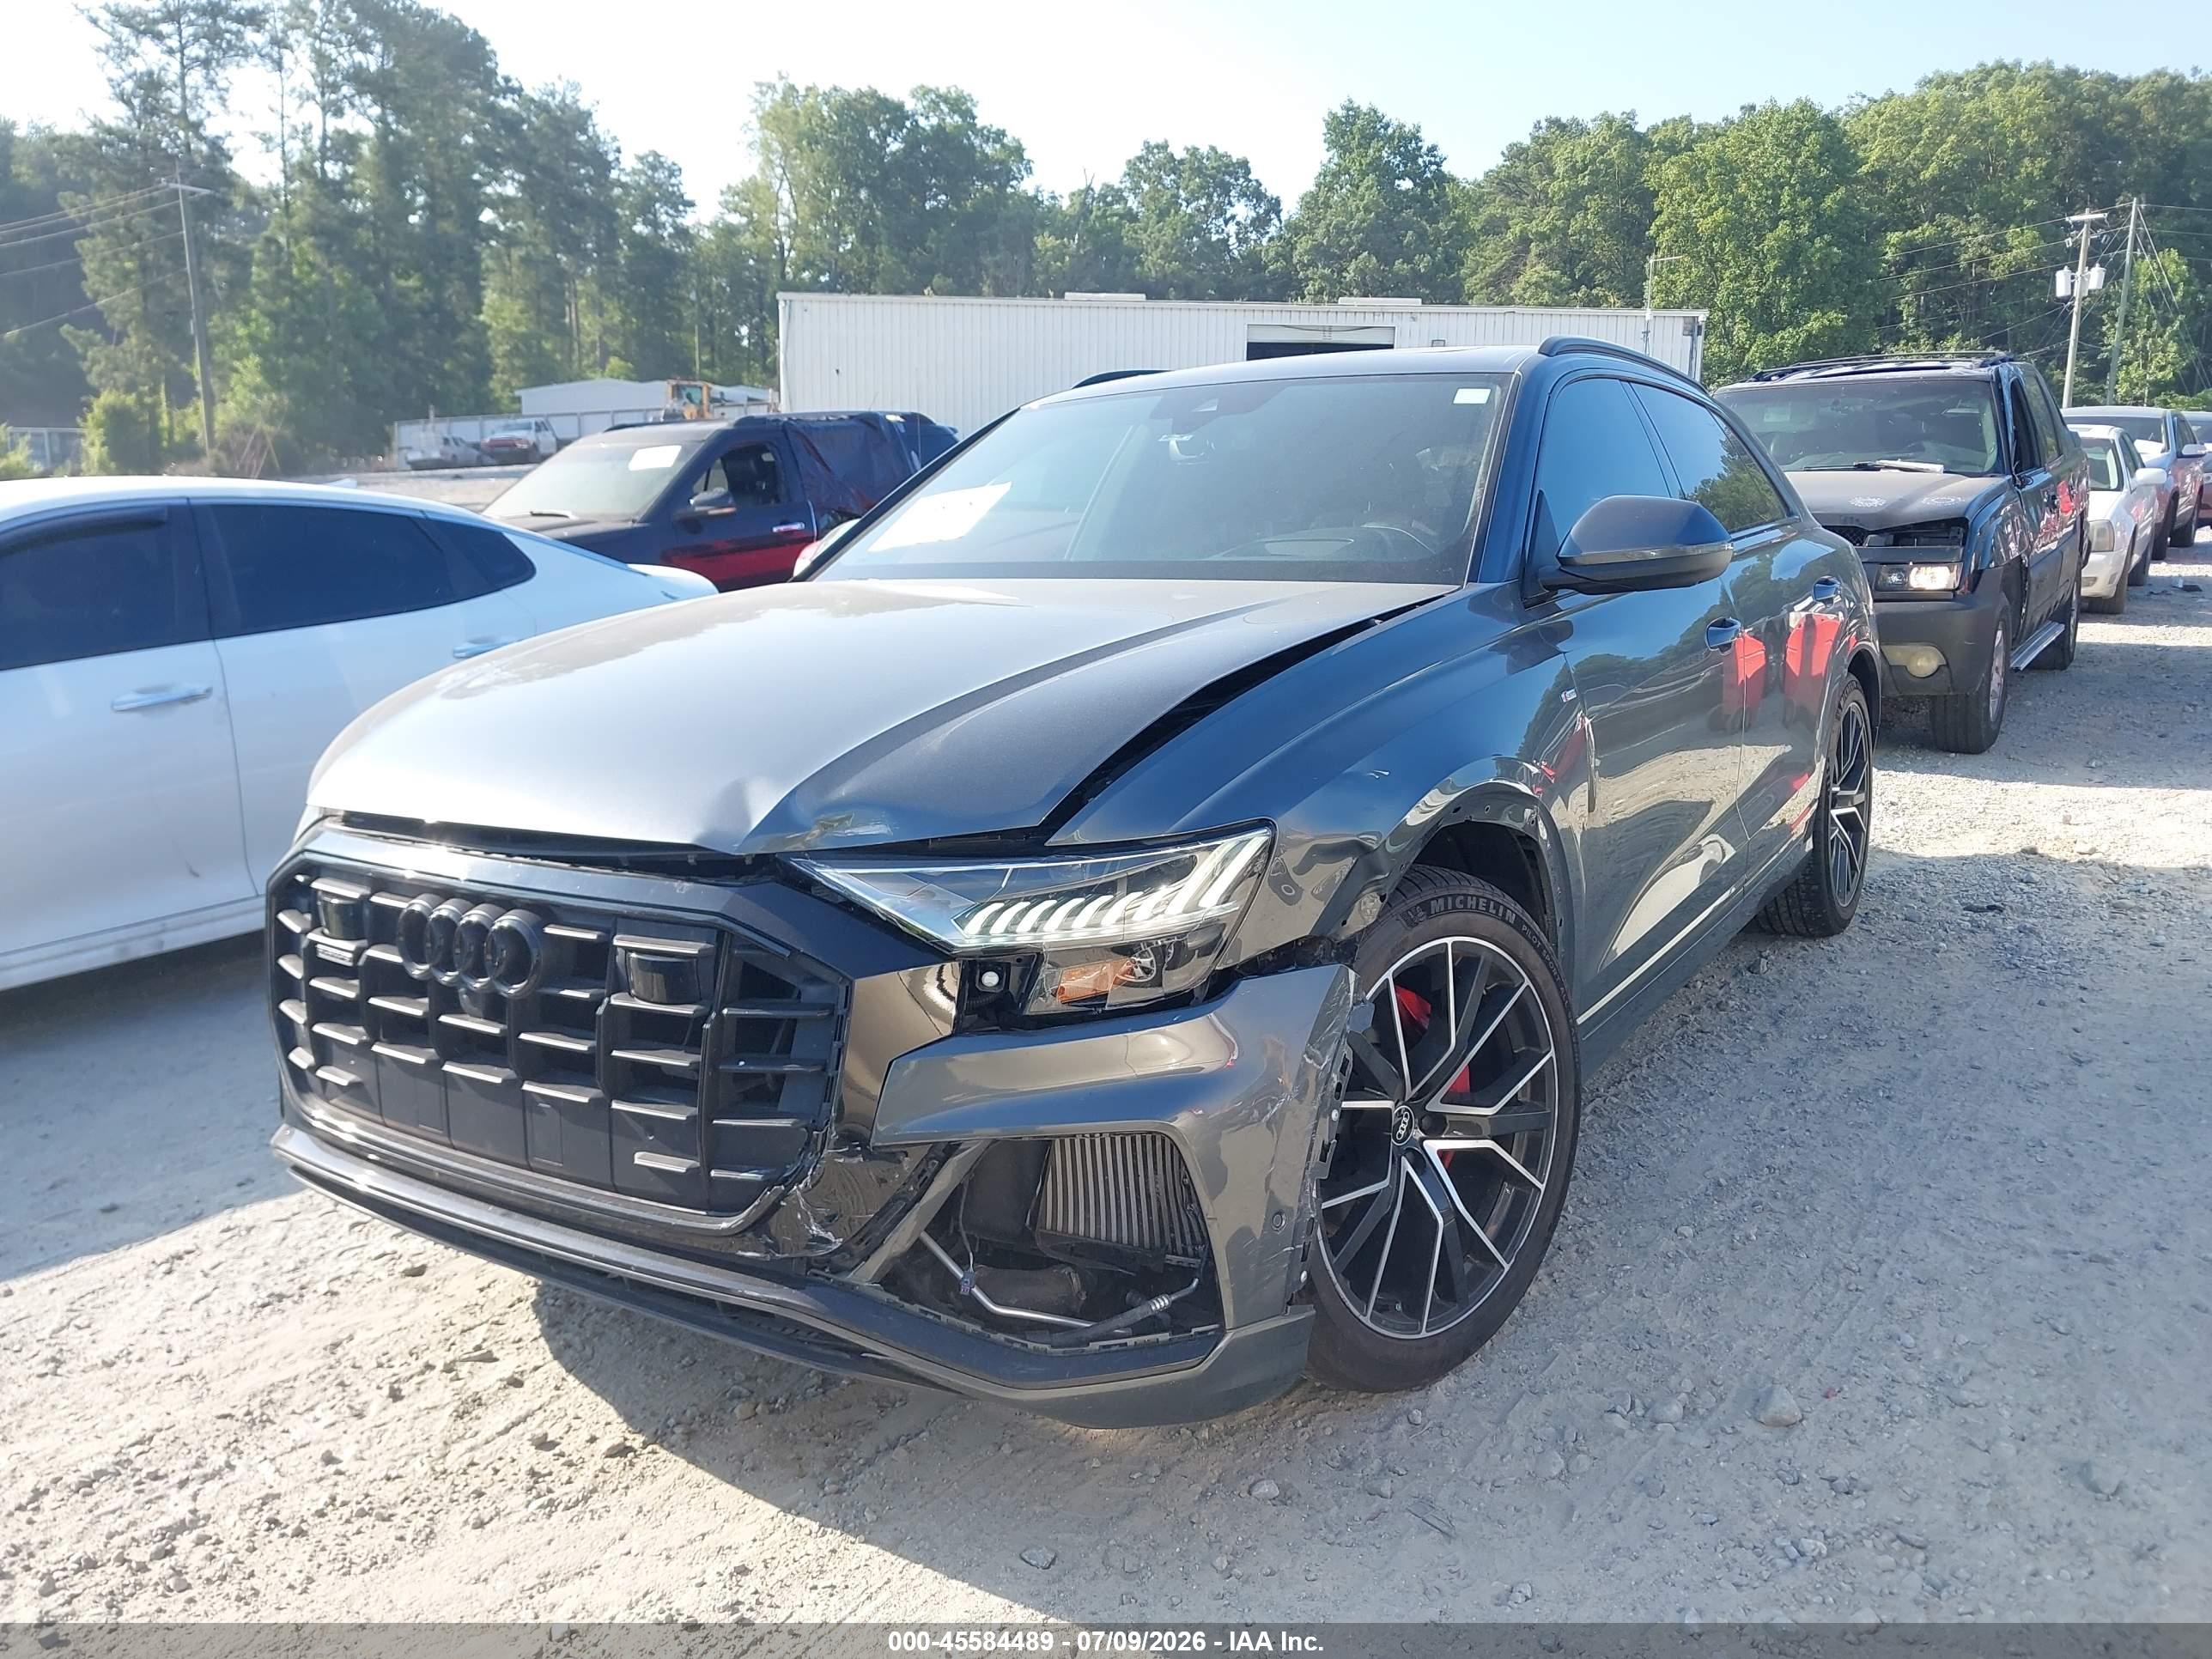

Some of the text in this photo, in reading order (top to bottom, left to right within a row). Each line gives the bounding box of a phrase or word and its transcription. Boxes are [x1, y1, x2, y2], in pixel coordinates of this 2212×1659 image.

[1431, 896, 1516, 924] MICHELIN
[1522, 924, 1540, 948] PILOT
[1541, 949, 1560, 981] SPORT
